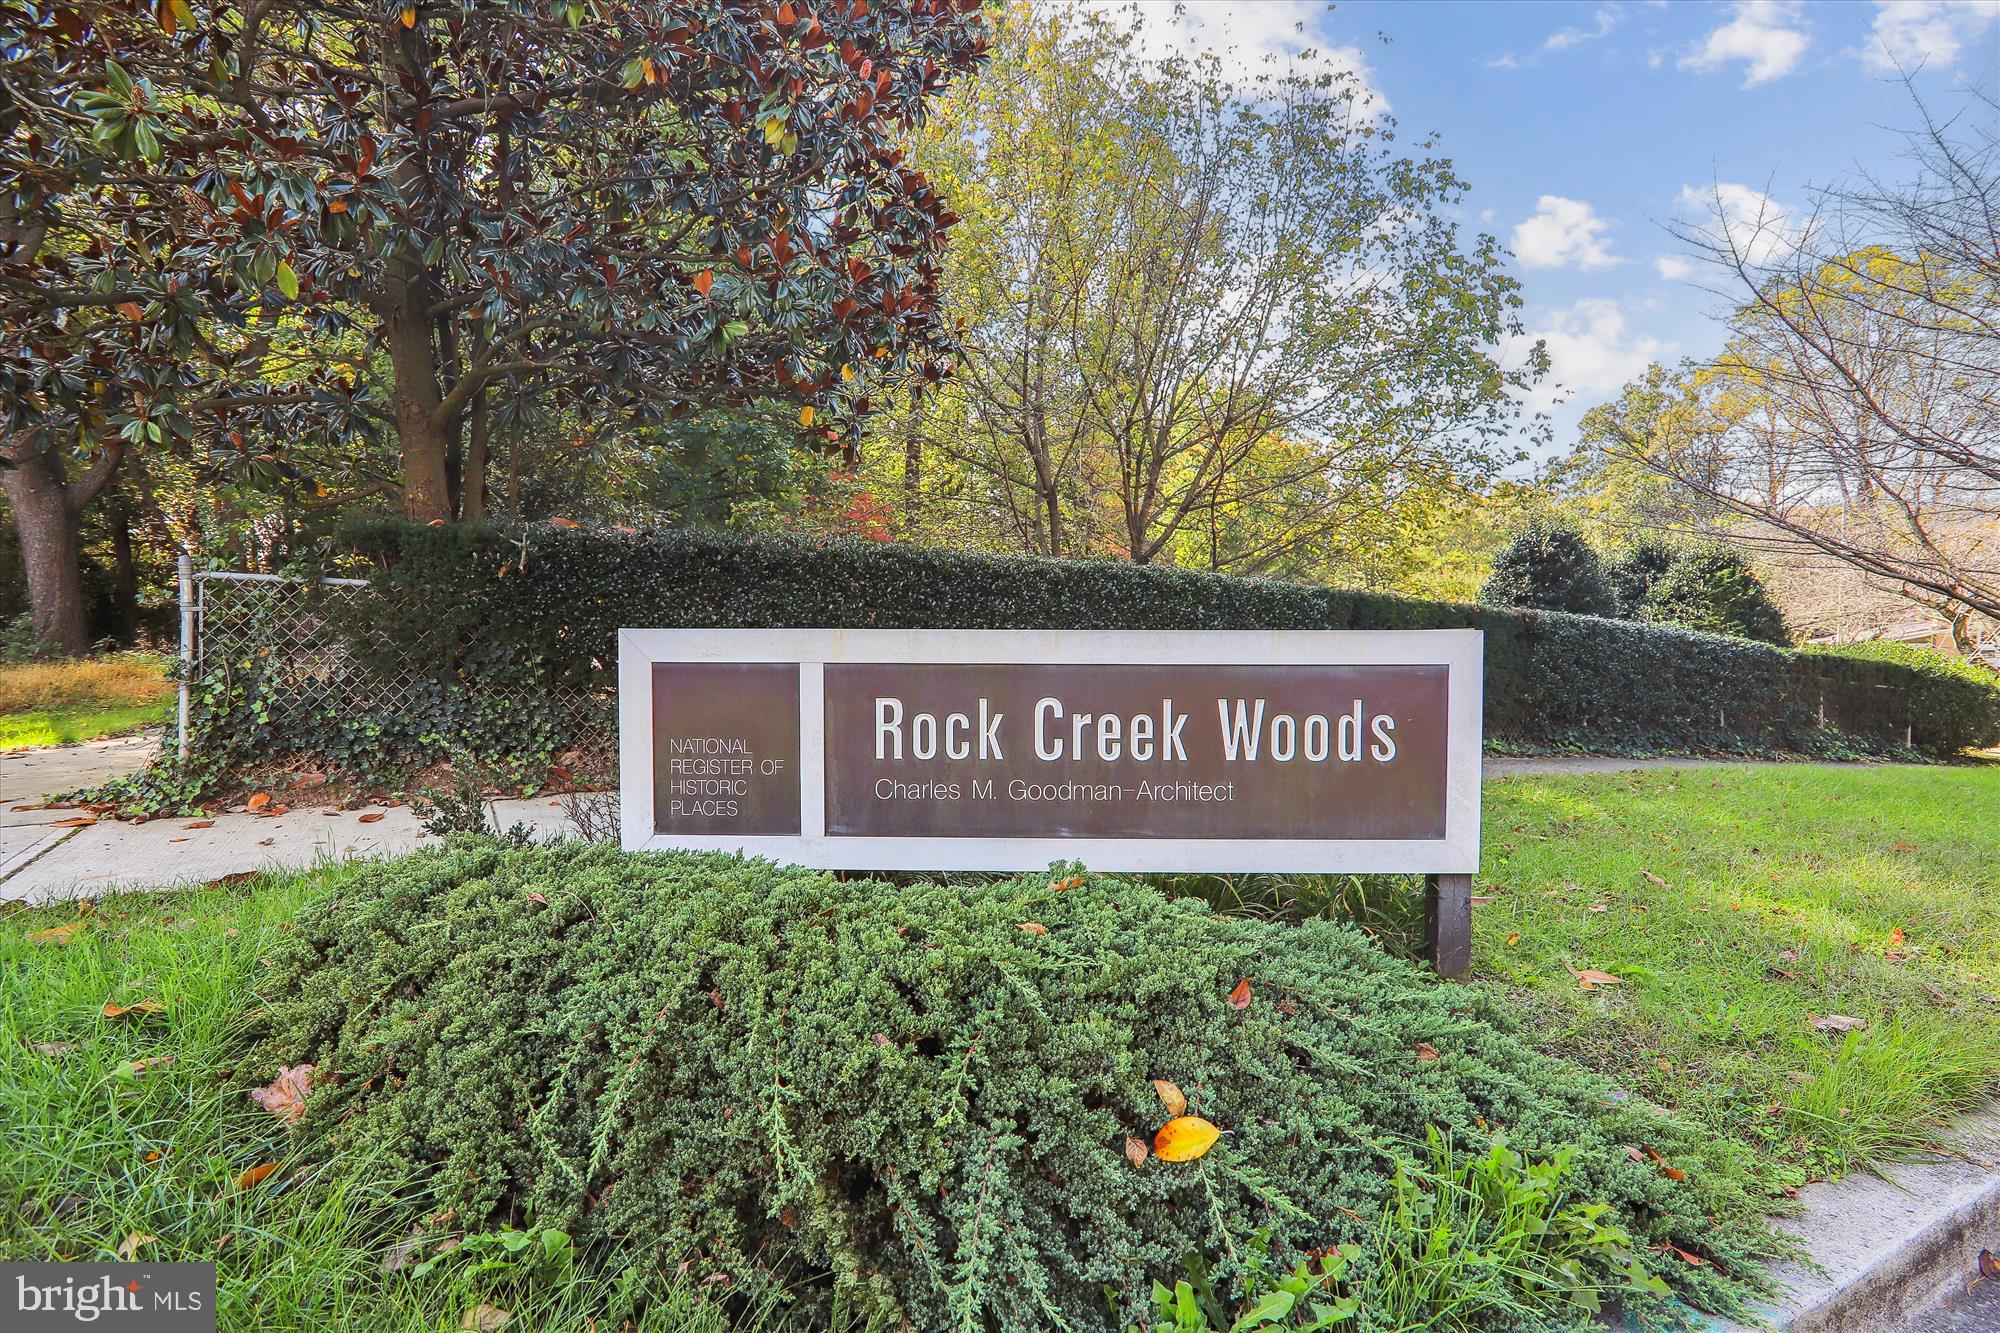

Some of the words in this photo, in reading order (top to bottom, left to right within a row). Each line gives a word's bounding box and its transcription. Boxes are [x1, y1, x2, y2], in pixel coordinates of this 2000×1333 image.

[874, 697, 1004, 760] Rock
[1033, 697, 1189, 762] Creek
[1217, 698, 1398, 762] Woods
[670, 738, 753, 754] NATIONAL
[670, 758, 753, 775] REGISTER
[760, 758, 785, 775] OF
[670, 779, 747, 796] HISTORIC
[874, 778, 960, 801] Charles
[972, 779, 997, 801] M.
[670, 800, 738, 817] PLACES
